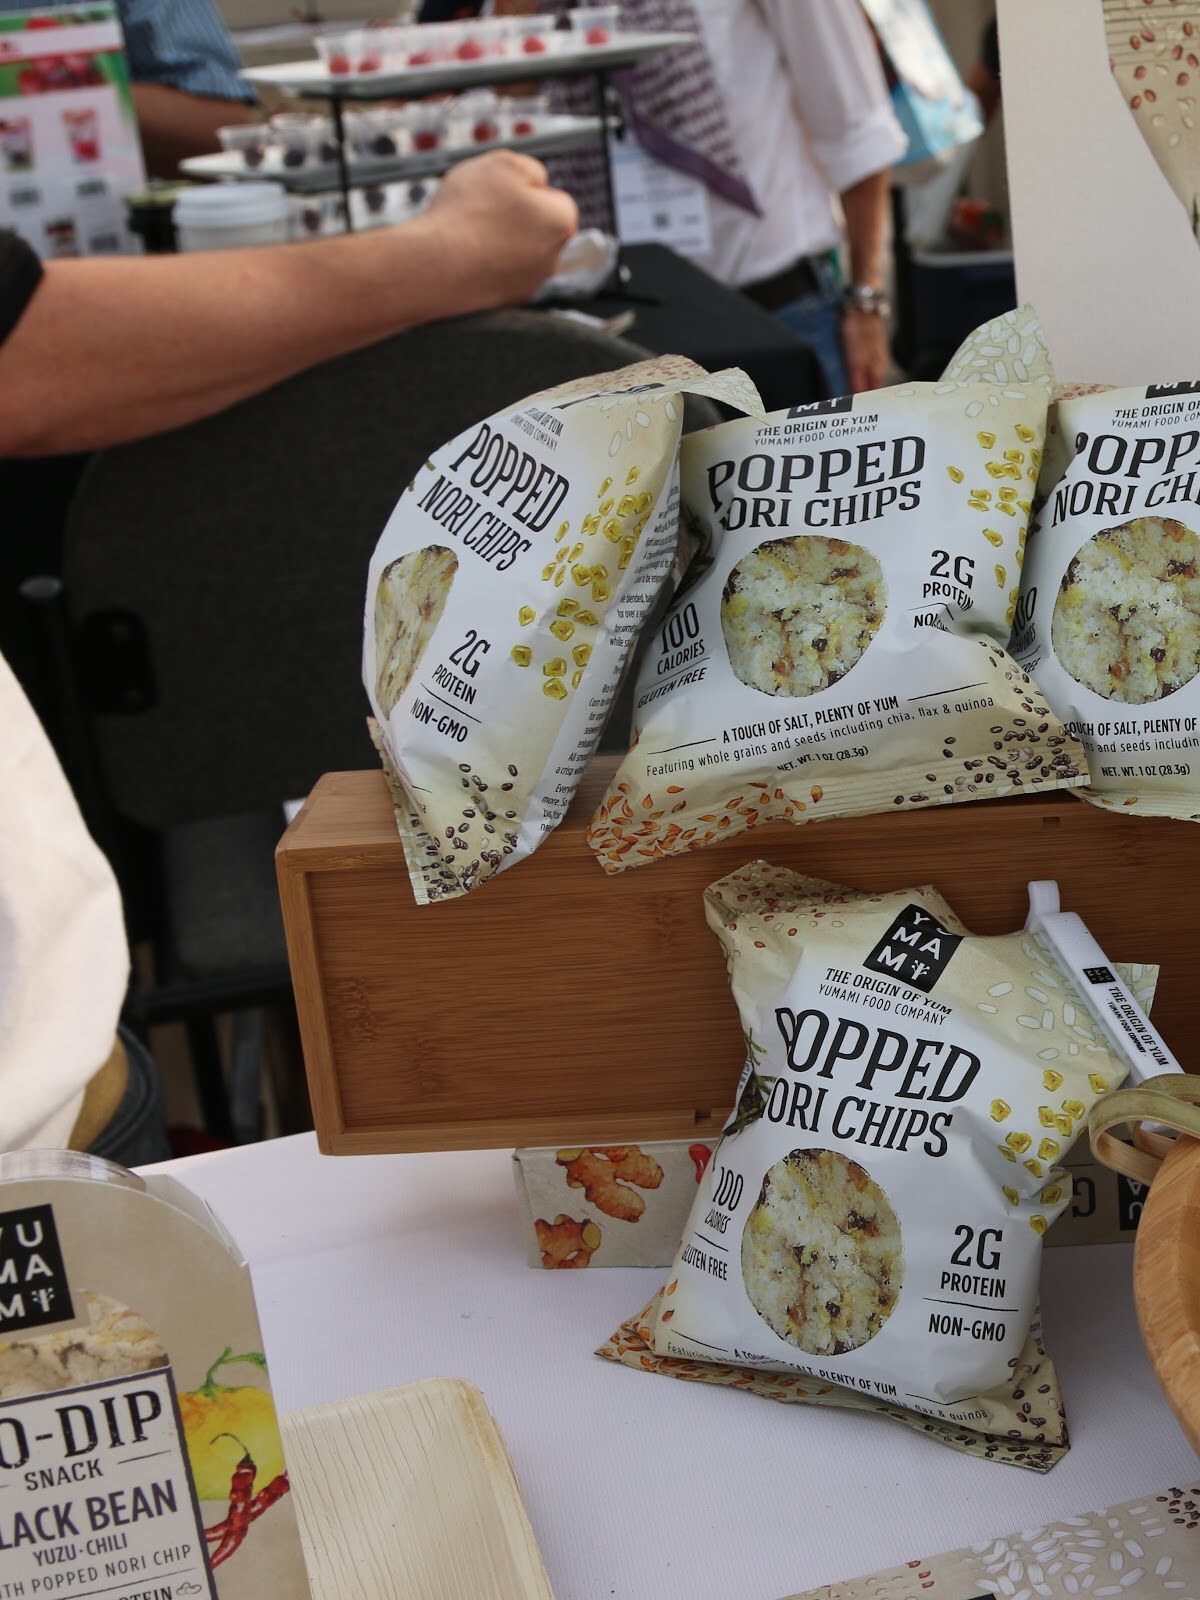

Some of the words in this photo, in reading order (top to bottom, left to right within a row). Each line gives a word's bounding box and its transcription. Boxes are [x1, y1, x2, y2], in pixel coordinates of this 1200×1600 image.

[756, 424, 781, 437] THE
[784, 420, 827, 435] ORIGIN
[831, 417, 848, 428] OF
[851, 414, 879, 425] YUM
[1111, 418, 1150, 429] YUMAMI
[1154, 416, 1180, 426] FOOD
[1114, 408, 1139, 419] THE
[1141, 402, 1185, 418] ORIGIN
[754, 436, 795, 446] YUMAMI
[799, 432, 825, 444] FOOD
[829, 424, 878, 439] COMPANY
[449, 423, 570, 533] POPPED
[706, 435, 926, 514] POPPED
[417, 474, 473, 537] NORI
[462, 511, 532, 571] CHIPS
[804, 480, 921, 527] CHIPS
[1051, 480, 1138, 529] NORI
[930, 550, 975, 589] 2G
[923, 582, 974, 612] PROTEIN
[661, 602, 700, 655] 100
[449, 629, 491, 679] 2G
[657, 639, 705, 675] CALORIES
[432, 663, 477, 705] PROTEIN
[638, 679, 677, 709] GLUTEN
[677, 667, 708, 688] FREE
[410, 697, 469, 743] NON-GMO
[647, 758, 694, 776] Featuring
[698, 750, 730, 767] whole
[733, 744, 768, 762] grains
[771, 738, 791, 752] and
[794, 731, 827, 747] seeds
[830, 719, 883, 739] including
[887, 712, 914, 725] chia,
[918, 707, 939, 717] flax
[943, 704, 950, 714] &
[955, 697, 994, 713] quinoa
[723, 730, 730, 743] A
[731, 722, 767, 742] TOUCH
[768, 719, 781, 734] OF
[784, 713, 814, 732] SALT,
[815, 705, 854, 726] PLENTY
[858, 701, 871, 716] OF
[873, 696, 899, 712] YUM
[892, 926, 941, 961] MA
[818, 983, 860, 1004] YUMAMI
[862, 994, 891, 1012] FOOD
[894, 1003, 947, 1026] COMPANY
[825, 968, 852, 985] THE
[852, 974, 901, 997] ORIGIN
[902, 990, 922, 1002] OF
[923, 998, 953, 1015] YUM
[1109, 986, 1127, 1003] THE
[1120, 1003, 1148, 1033] ORIGIN
[1141, 1034, 1156, 1046] OF
[1149, 1044, 1170, 1066] YUM
[832, 1088, 954, 1157] CHIPS
[712, 1166, 744, 1212] 100
[950, 1224, 1004, 1271] 2G
[940, 1271, 1006, 1299] PROTEIN
[928, 1313, 1006, 1342] NON-GMO
[24, 1458, 104, 1491] SNACK
[85, 1479, 178, 1531] BEAN
[32, 1567, 99, 1593] POPPED
[105, 1555, 147, 1578] NORI
[153, 1544, 191, 1566] CHIP
